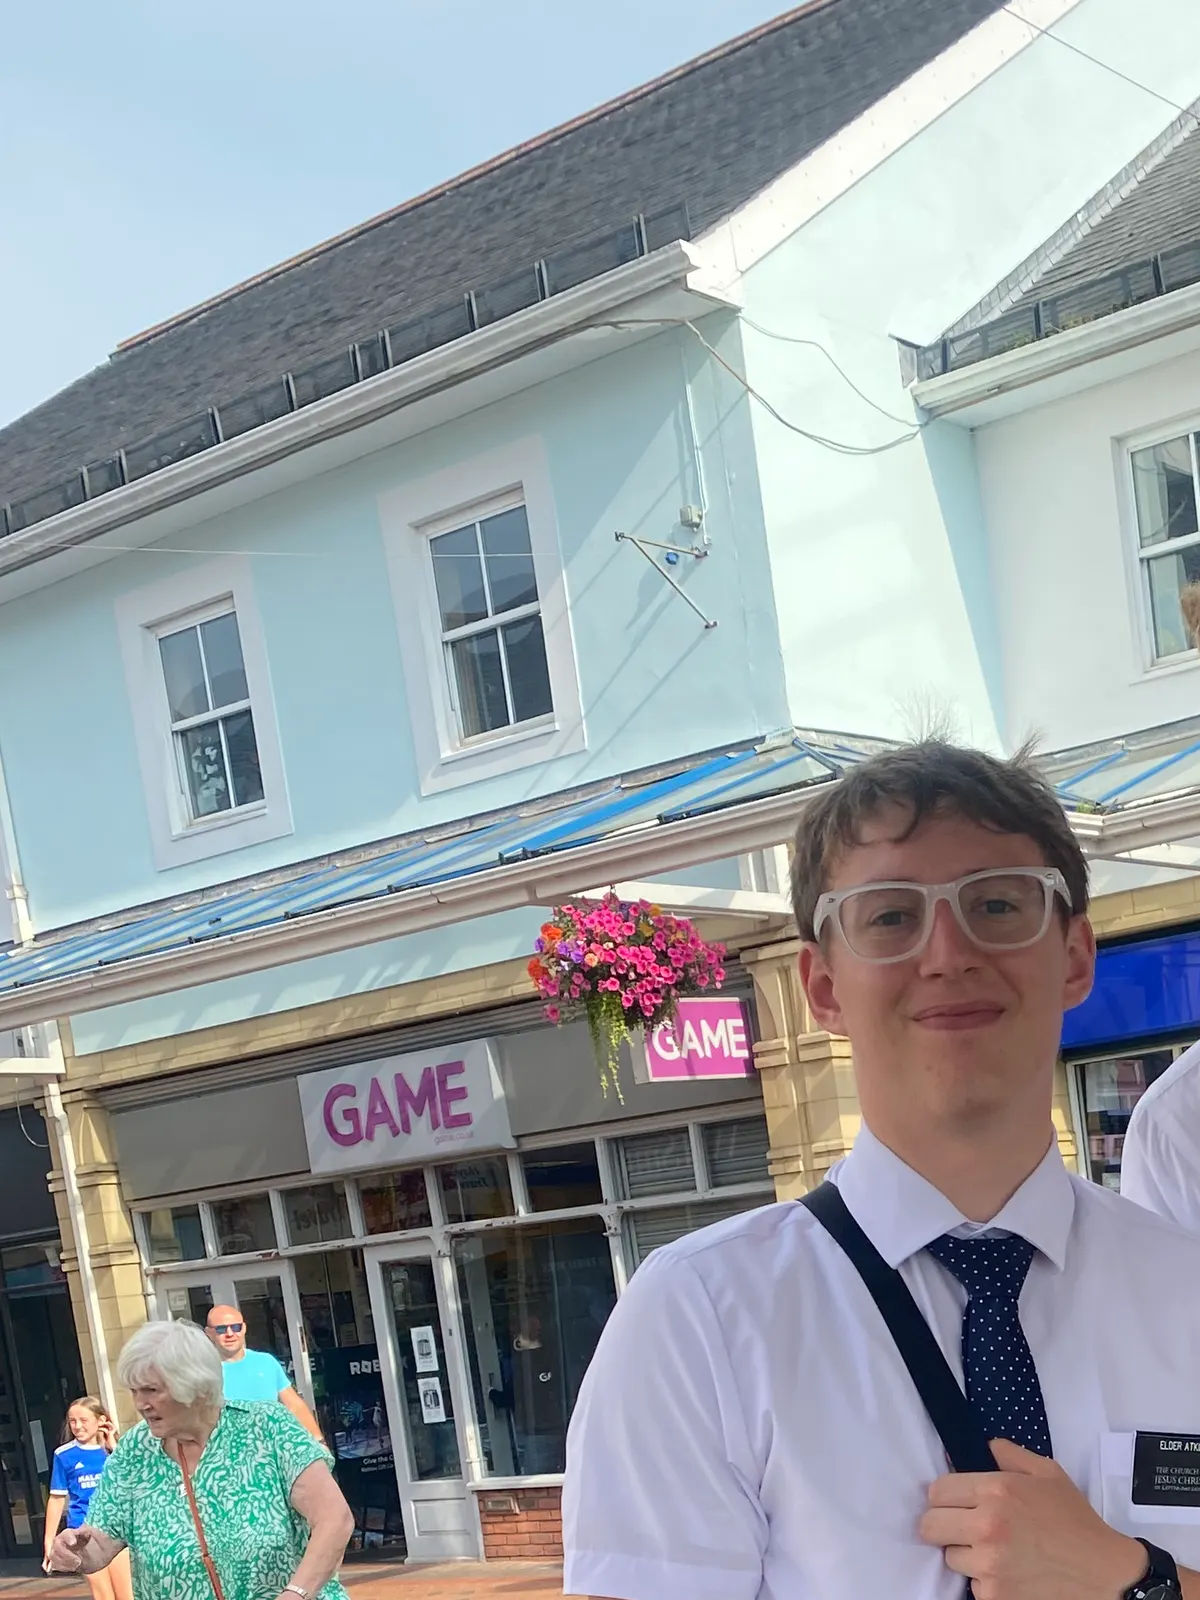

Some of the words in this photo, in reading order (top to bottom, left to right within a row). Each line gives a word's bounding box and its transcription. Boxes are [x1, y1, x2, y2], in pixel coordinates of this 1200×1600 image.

[652, 1018, 749, 1061] GAME
[323, 1060, 473, 1147] GAME
[1159, 1440, 1182, 1451] ELDER
[362, 1457, 377, 1465] Give
[1156, 1466, 1169, 1474] THE
[1170, 1467, 1199, 1475] CHURCH
[1154, 1475, 1177, 1484] JESUS
